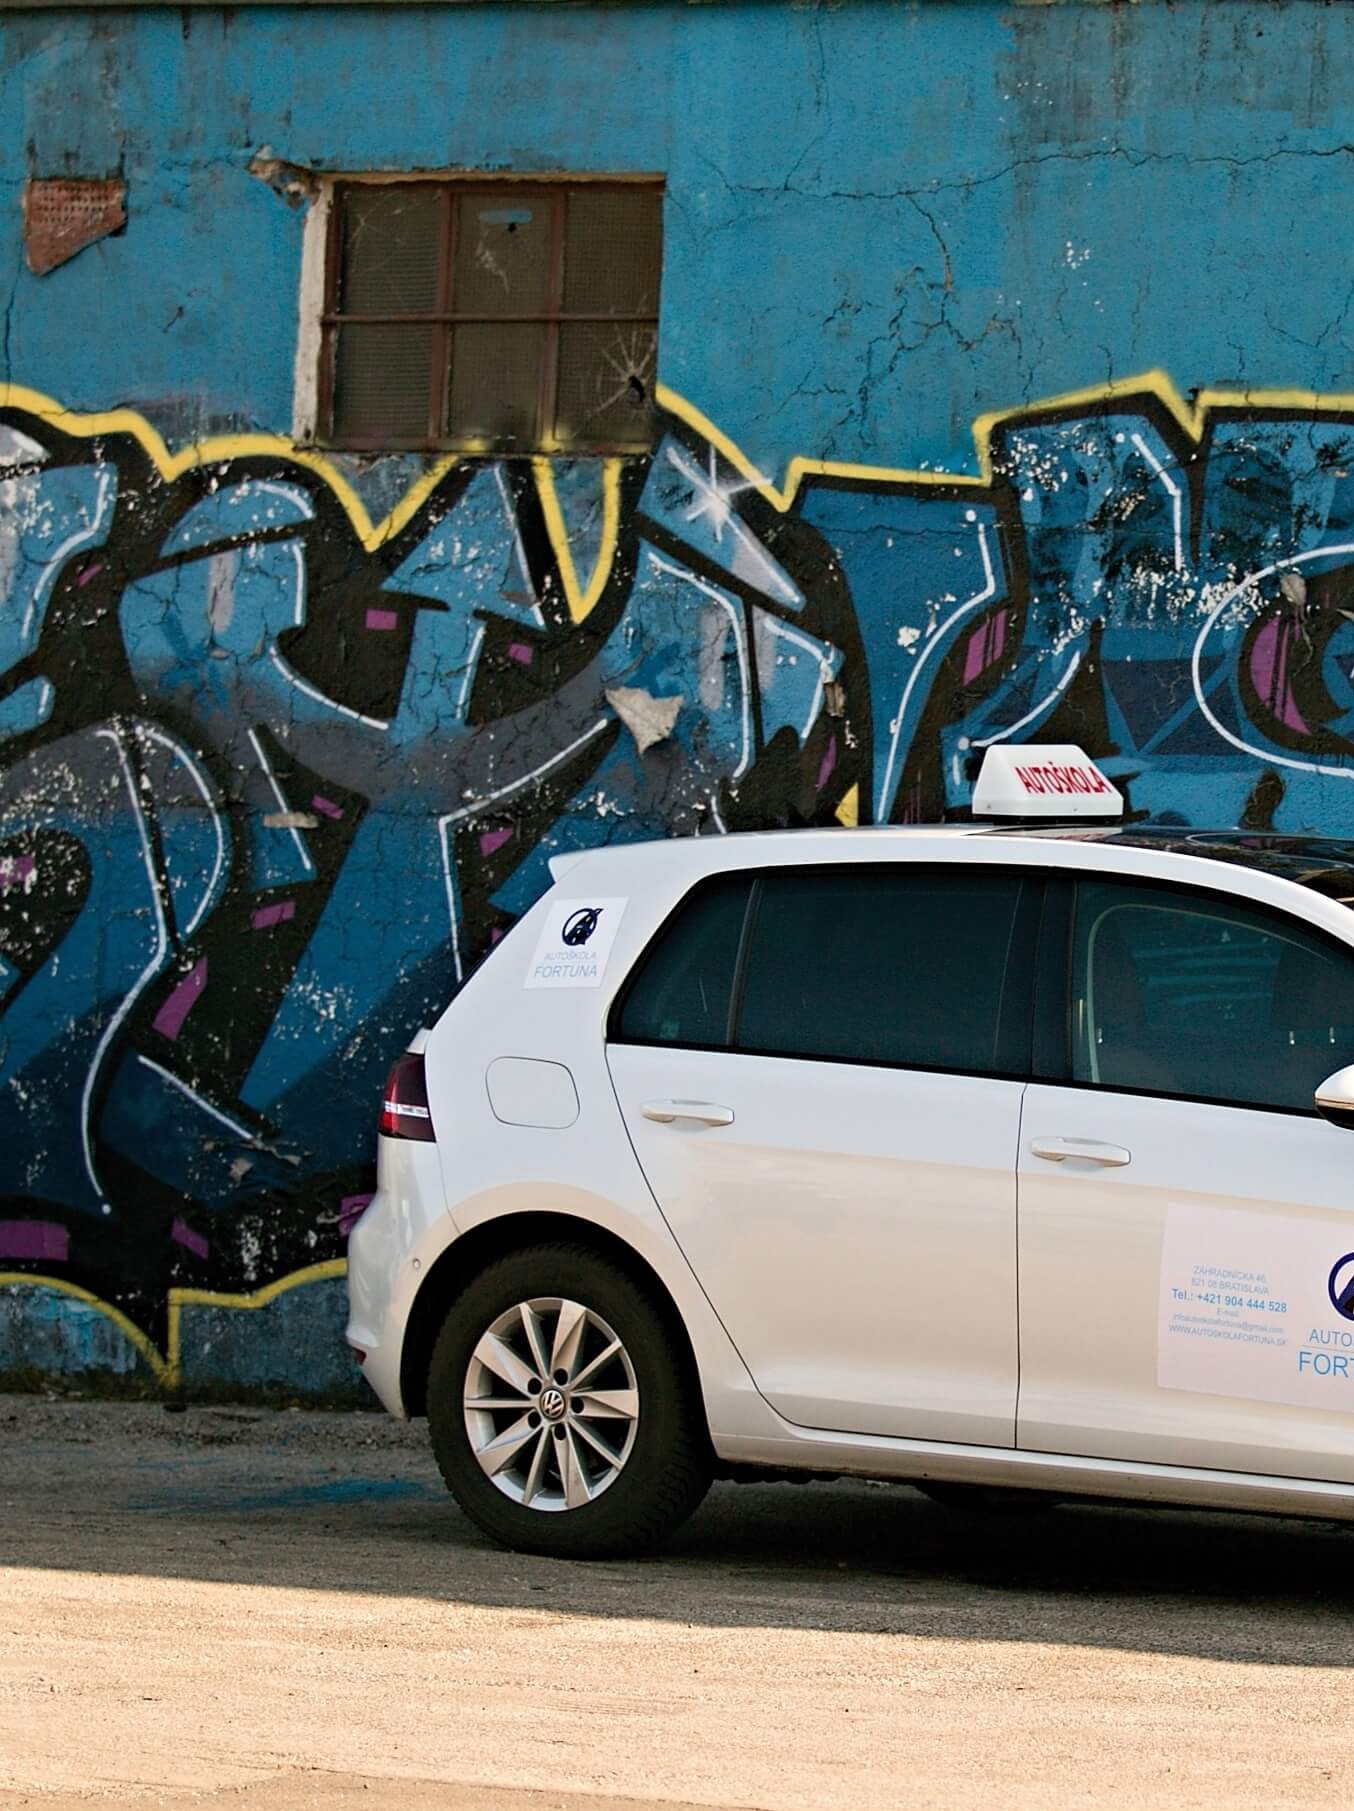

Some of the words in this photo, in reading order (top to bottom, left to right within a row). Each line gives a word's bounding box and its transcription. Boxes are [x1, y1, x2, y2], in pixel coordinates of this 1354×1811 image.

[1014, 761, 1112, 794] AUTOŠKOLA
[534, 964, 598, 978] FORTUNA
[1218, 1280, 1270, 1296] BRATISLAVA
[1172, 1288, 1194, 1301] Tel.:
[1197, 1293, 1221, 1305] +421
[1224, 1295, 1243, 1307] 904
[1246, 1298, 1265, 1310] 444
[1268, 1300, 1288, 1313] 528
